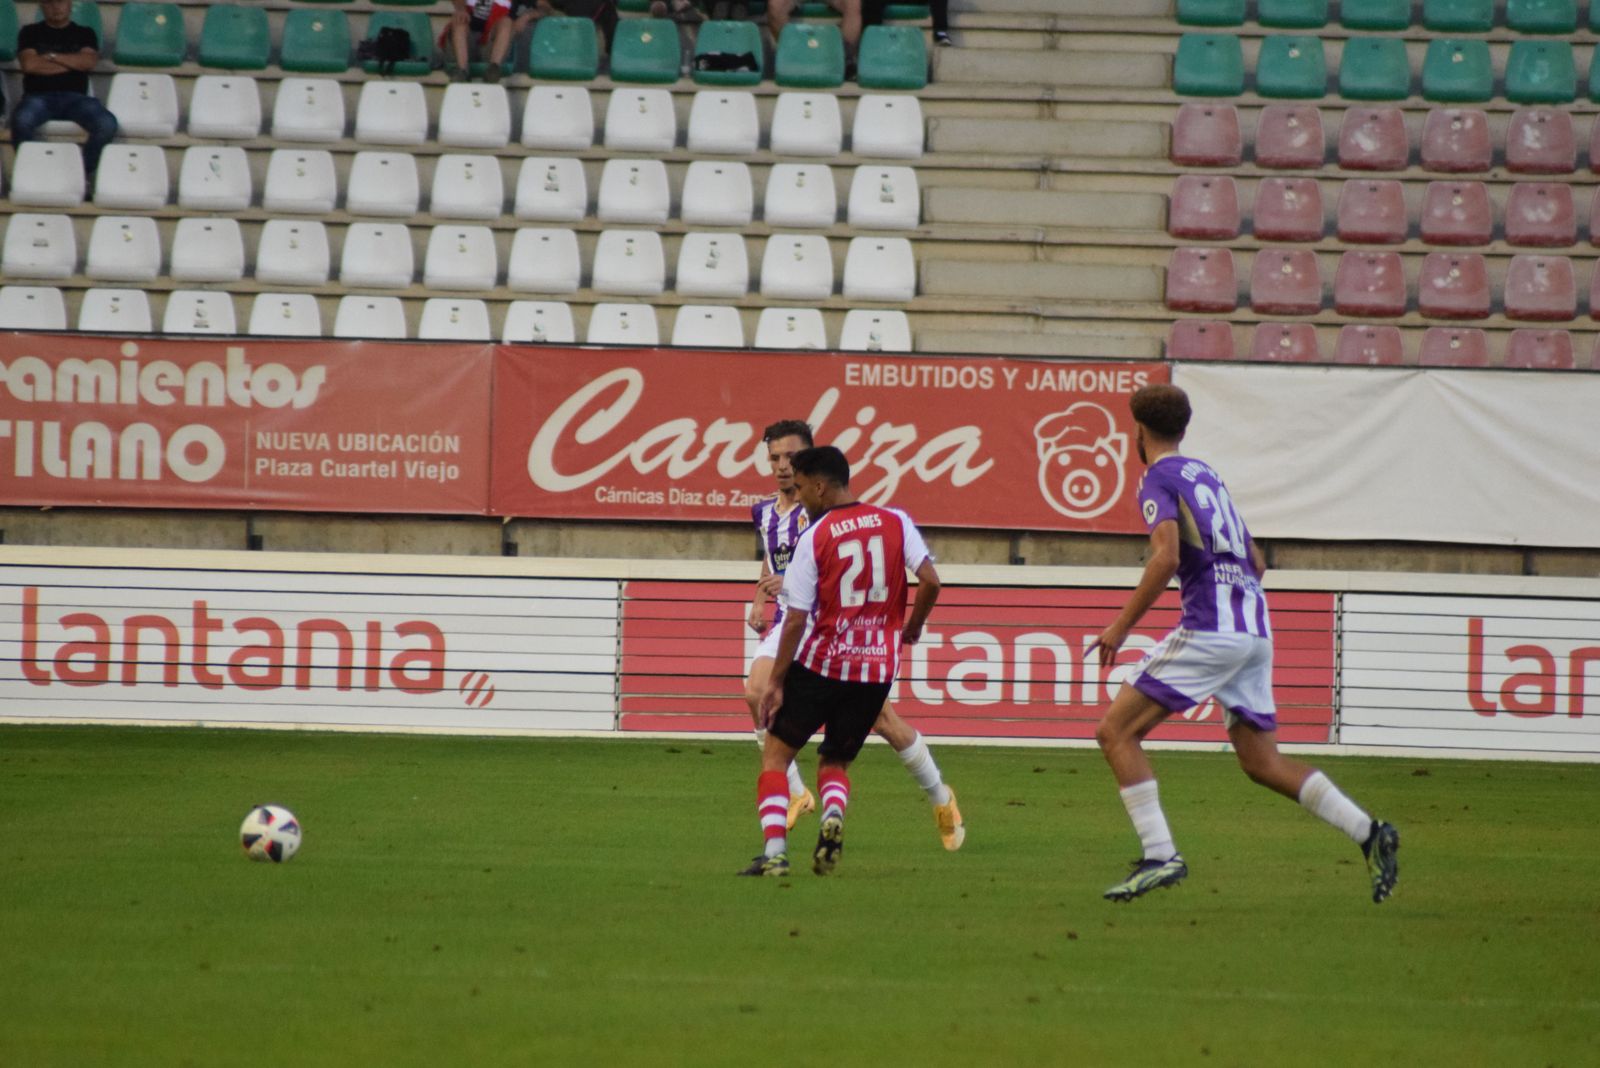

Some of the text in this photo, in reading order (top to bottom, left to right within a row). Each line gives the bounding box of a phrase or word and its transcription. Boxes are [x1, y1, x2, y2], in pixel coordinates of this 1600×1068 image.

[845, 363, 1148, 393] EMBUTIDOS Y JAMONES
[0, 419, 226, 483] ILANO
[256, 431, 460, 453] NUEVA UBICACIÓN
[255, 457, 460, 483] Plaza Cuartel Viejo
[594, 485, 664, 504] Cárnicas
[669, 487, 703, 505] Díaz
[706, 489, 726, 506] de
[838, 535, 889, 608] 21
[20, 586, 446, 694] lantania
[743, 602, 1159, 705] tania
